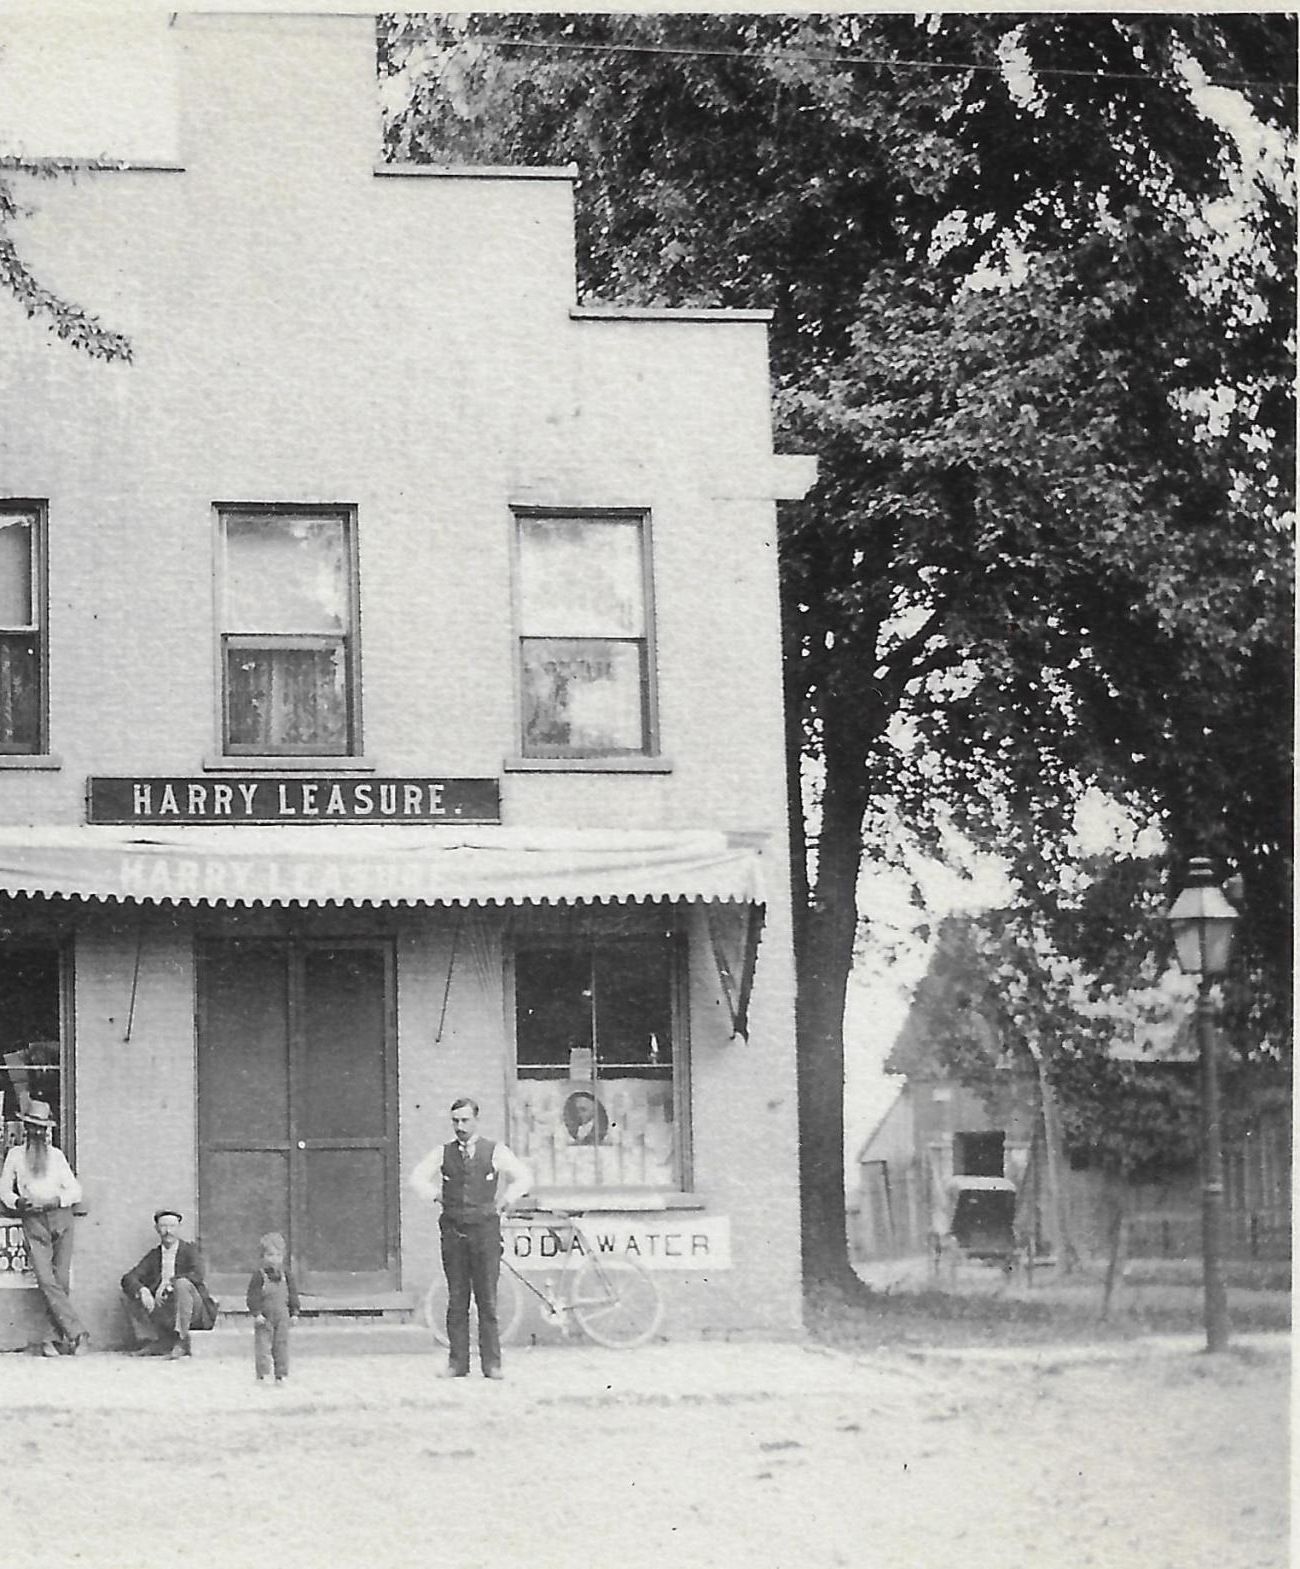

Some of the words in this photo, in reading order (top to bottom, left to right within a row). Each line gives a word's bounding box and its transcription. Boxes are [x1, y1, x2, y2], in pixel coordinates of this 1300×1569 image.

[133, 783, 258, 815] HARRY
[278, 784, 463, 816] LEASURE.
[119, 857, 254, 891] HARRY
[500, 1234, 586, 1258] ODA
[596, 1234, 710, 1257] WATER
